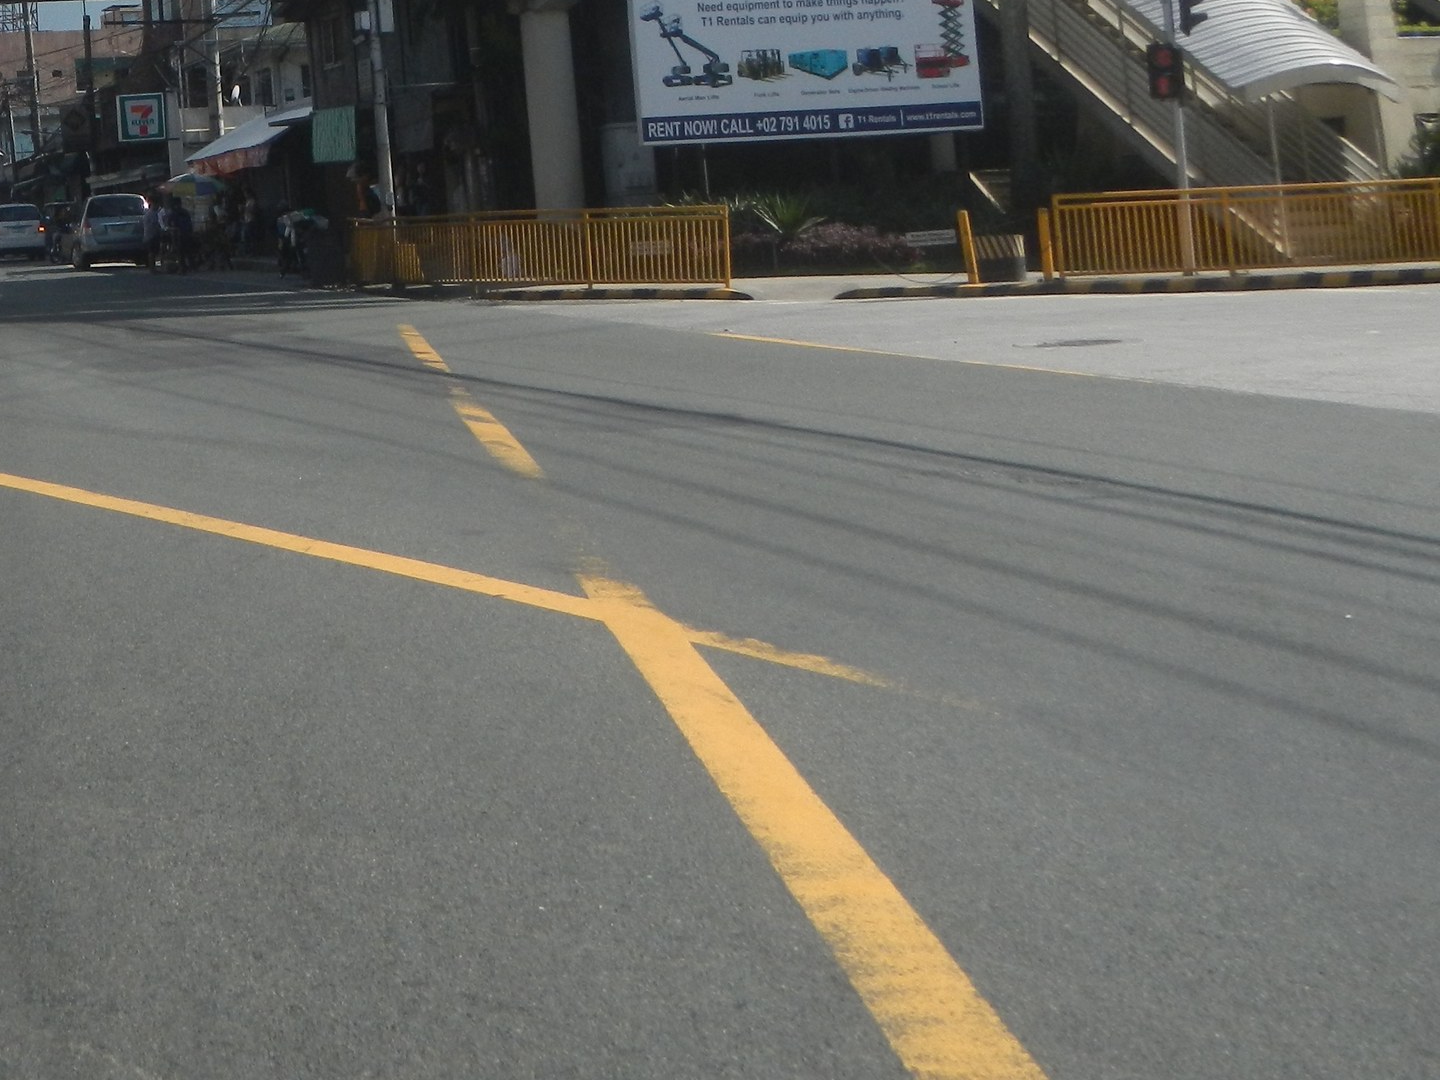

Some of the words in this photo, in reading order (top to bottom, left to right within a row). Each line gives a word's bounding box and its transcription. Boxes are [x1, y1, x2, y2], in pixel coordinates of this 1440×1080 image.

[697, 2, 723, 13] Need
[726, 0, 780, 13] equipment
[782, 0, 793, 9] to
[701, 16, 713, 27] T1
[716, 15, 755, 27] Rentals
[757, 15, 776, 25] can
[778, 12, 808, 26] equip
[811, 12, 830, 25] you
[832, 10, 854, 21] with
[856, 8, 904, 22] anything.
[130, 104, 153, 136] 7
[648, 121, 681, 138] RENT
[684, 119, 718, 137] NOW!
[720, 118, 754, 135] CALL
[756, 117, 777, 133] +02
[779, 116, 799, 132] 791
[802, 114, 831, 131] 4015
[868, 114, 897, 124] Rentals
